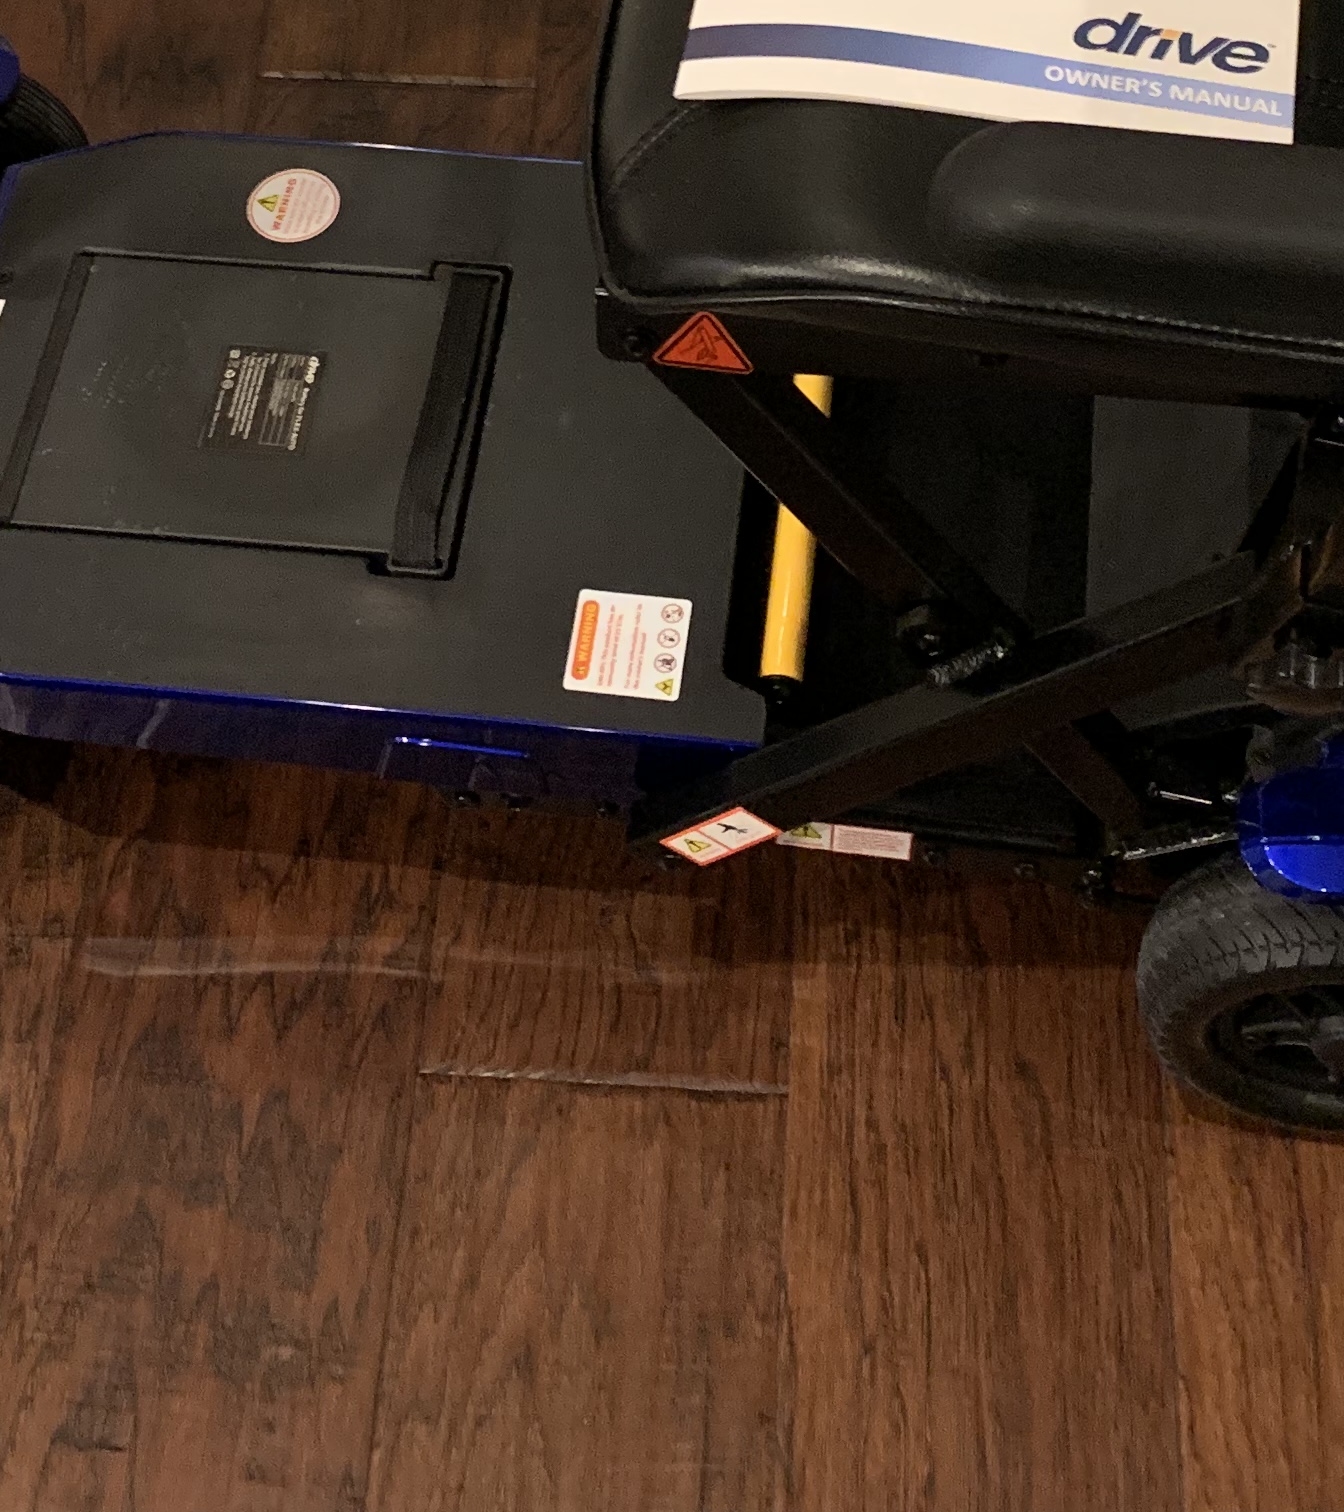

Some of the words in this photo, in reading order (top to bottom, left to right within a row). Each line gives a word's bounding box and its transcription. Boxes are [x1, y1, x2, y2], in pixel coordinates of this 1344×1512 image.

[1073, 11, 1271, 74] drive
[1044, 65, 1163, 98] OWNER'S
[1169, 84, 1283, 117] MANUAL
[272, 178, 297, 231] WARNING
[577, 603, 598, 662] WARNING
